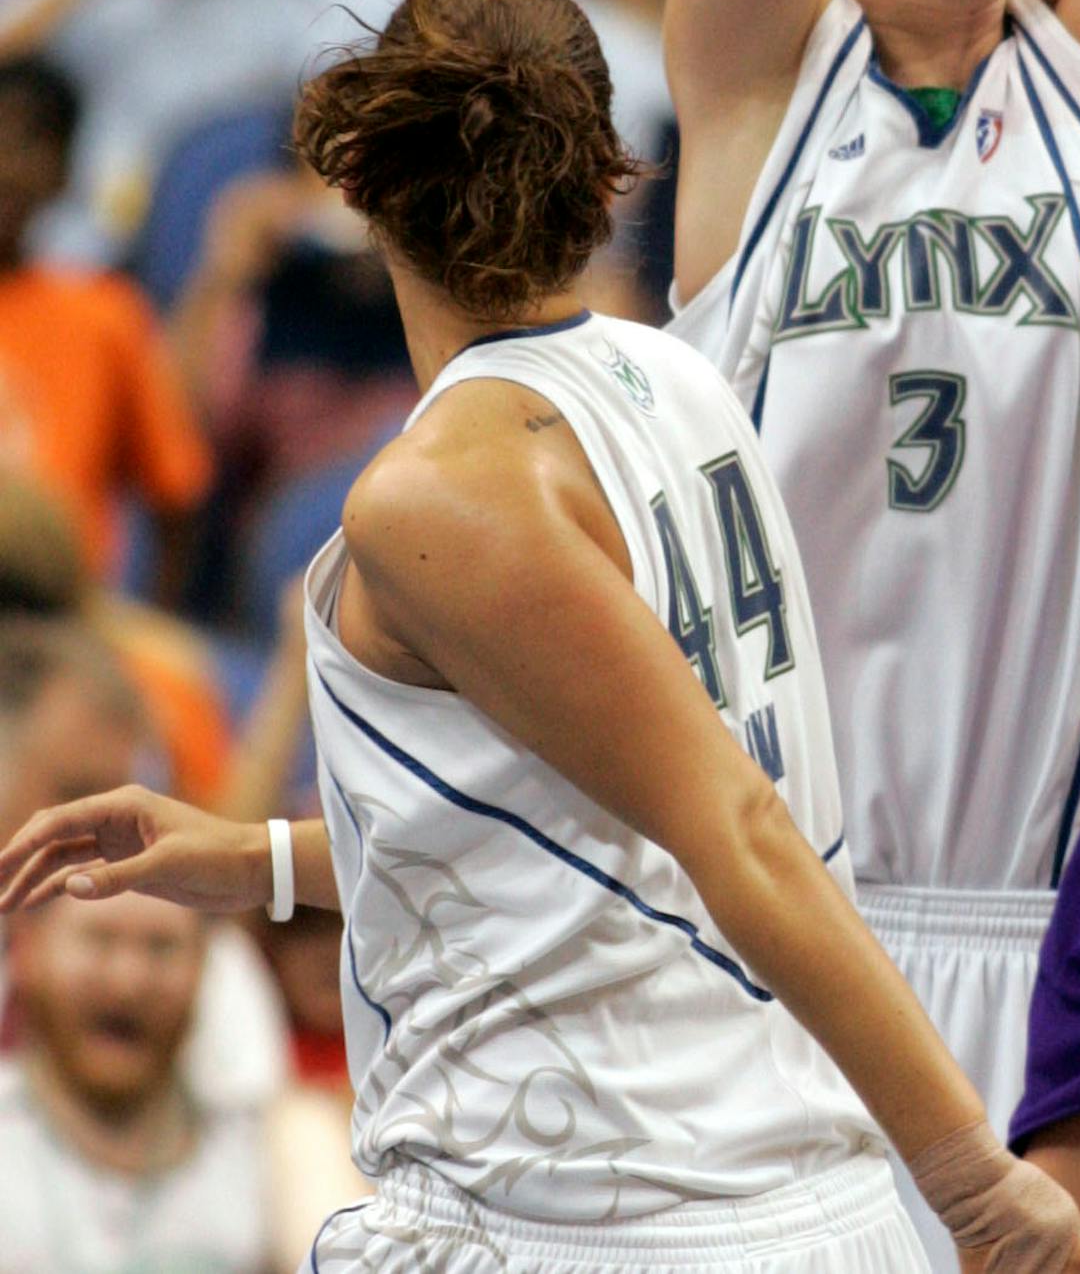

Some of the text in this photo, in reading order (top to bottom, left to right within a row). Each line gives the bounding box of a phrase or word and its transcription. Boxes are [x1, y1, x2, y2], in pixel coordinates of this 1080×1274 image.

[772, 192, 1080, 345] LYNX
[886, 369, 967, 513] 3
[649, 450, 795, 710] 44
